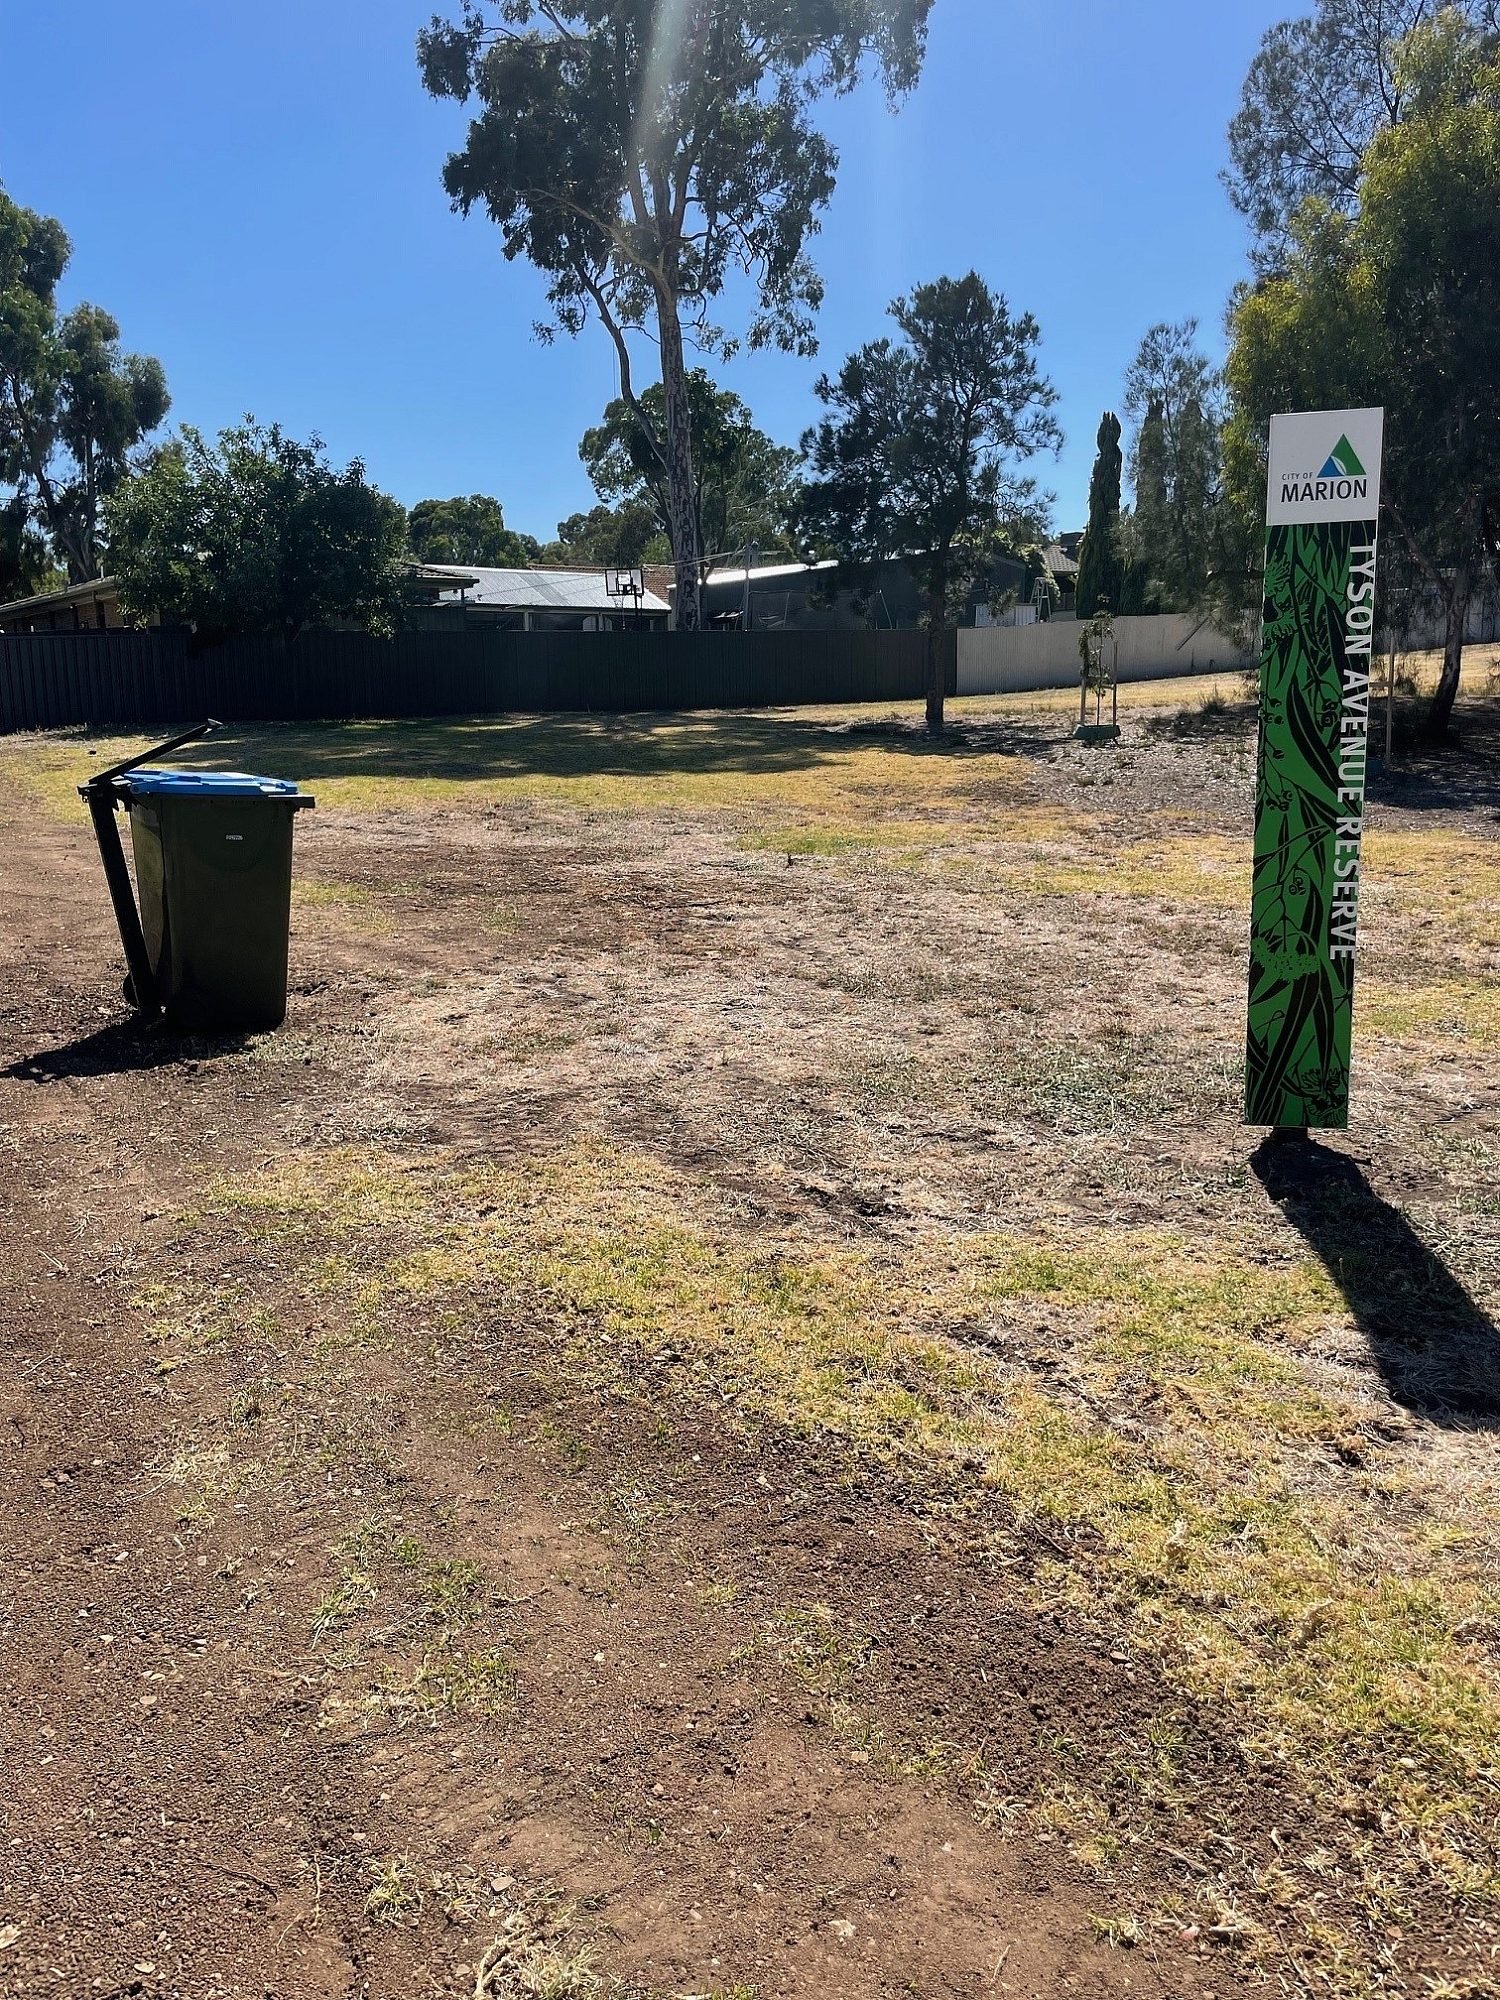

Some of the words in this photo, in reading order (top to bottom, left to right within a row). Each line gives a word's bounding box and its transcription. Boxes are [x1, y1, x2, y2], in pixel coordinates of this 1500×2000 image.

[1280, 479, 1367, 503] MARION
[1281, 473, 1300, 481] CITY
[1302, 472, 1313, 480] OF
[1344, 538, 1377, 655] TYSON
[1337, 669, 1369, 803] AVENUE
[1329, 816, 1363, 960] RESERVE
